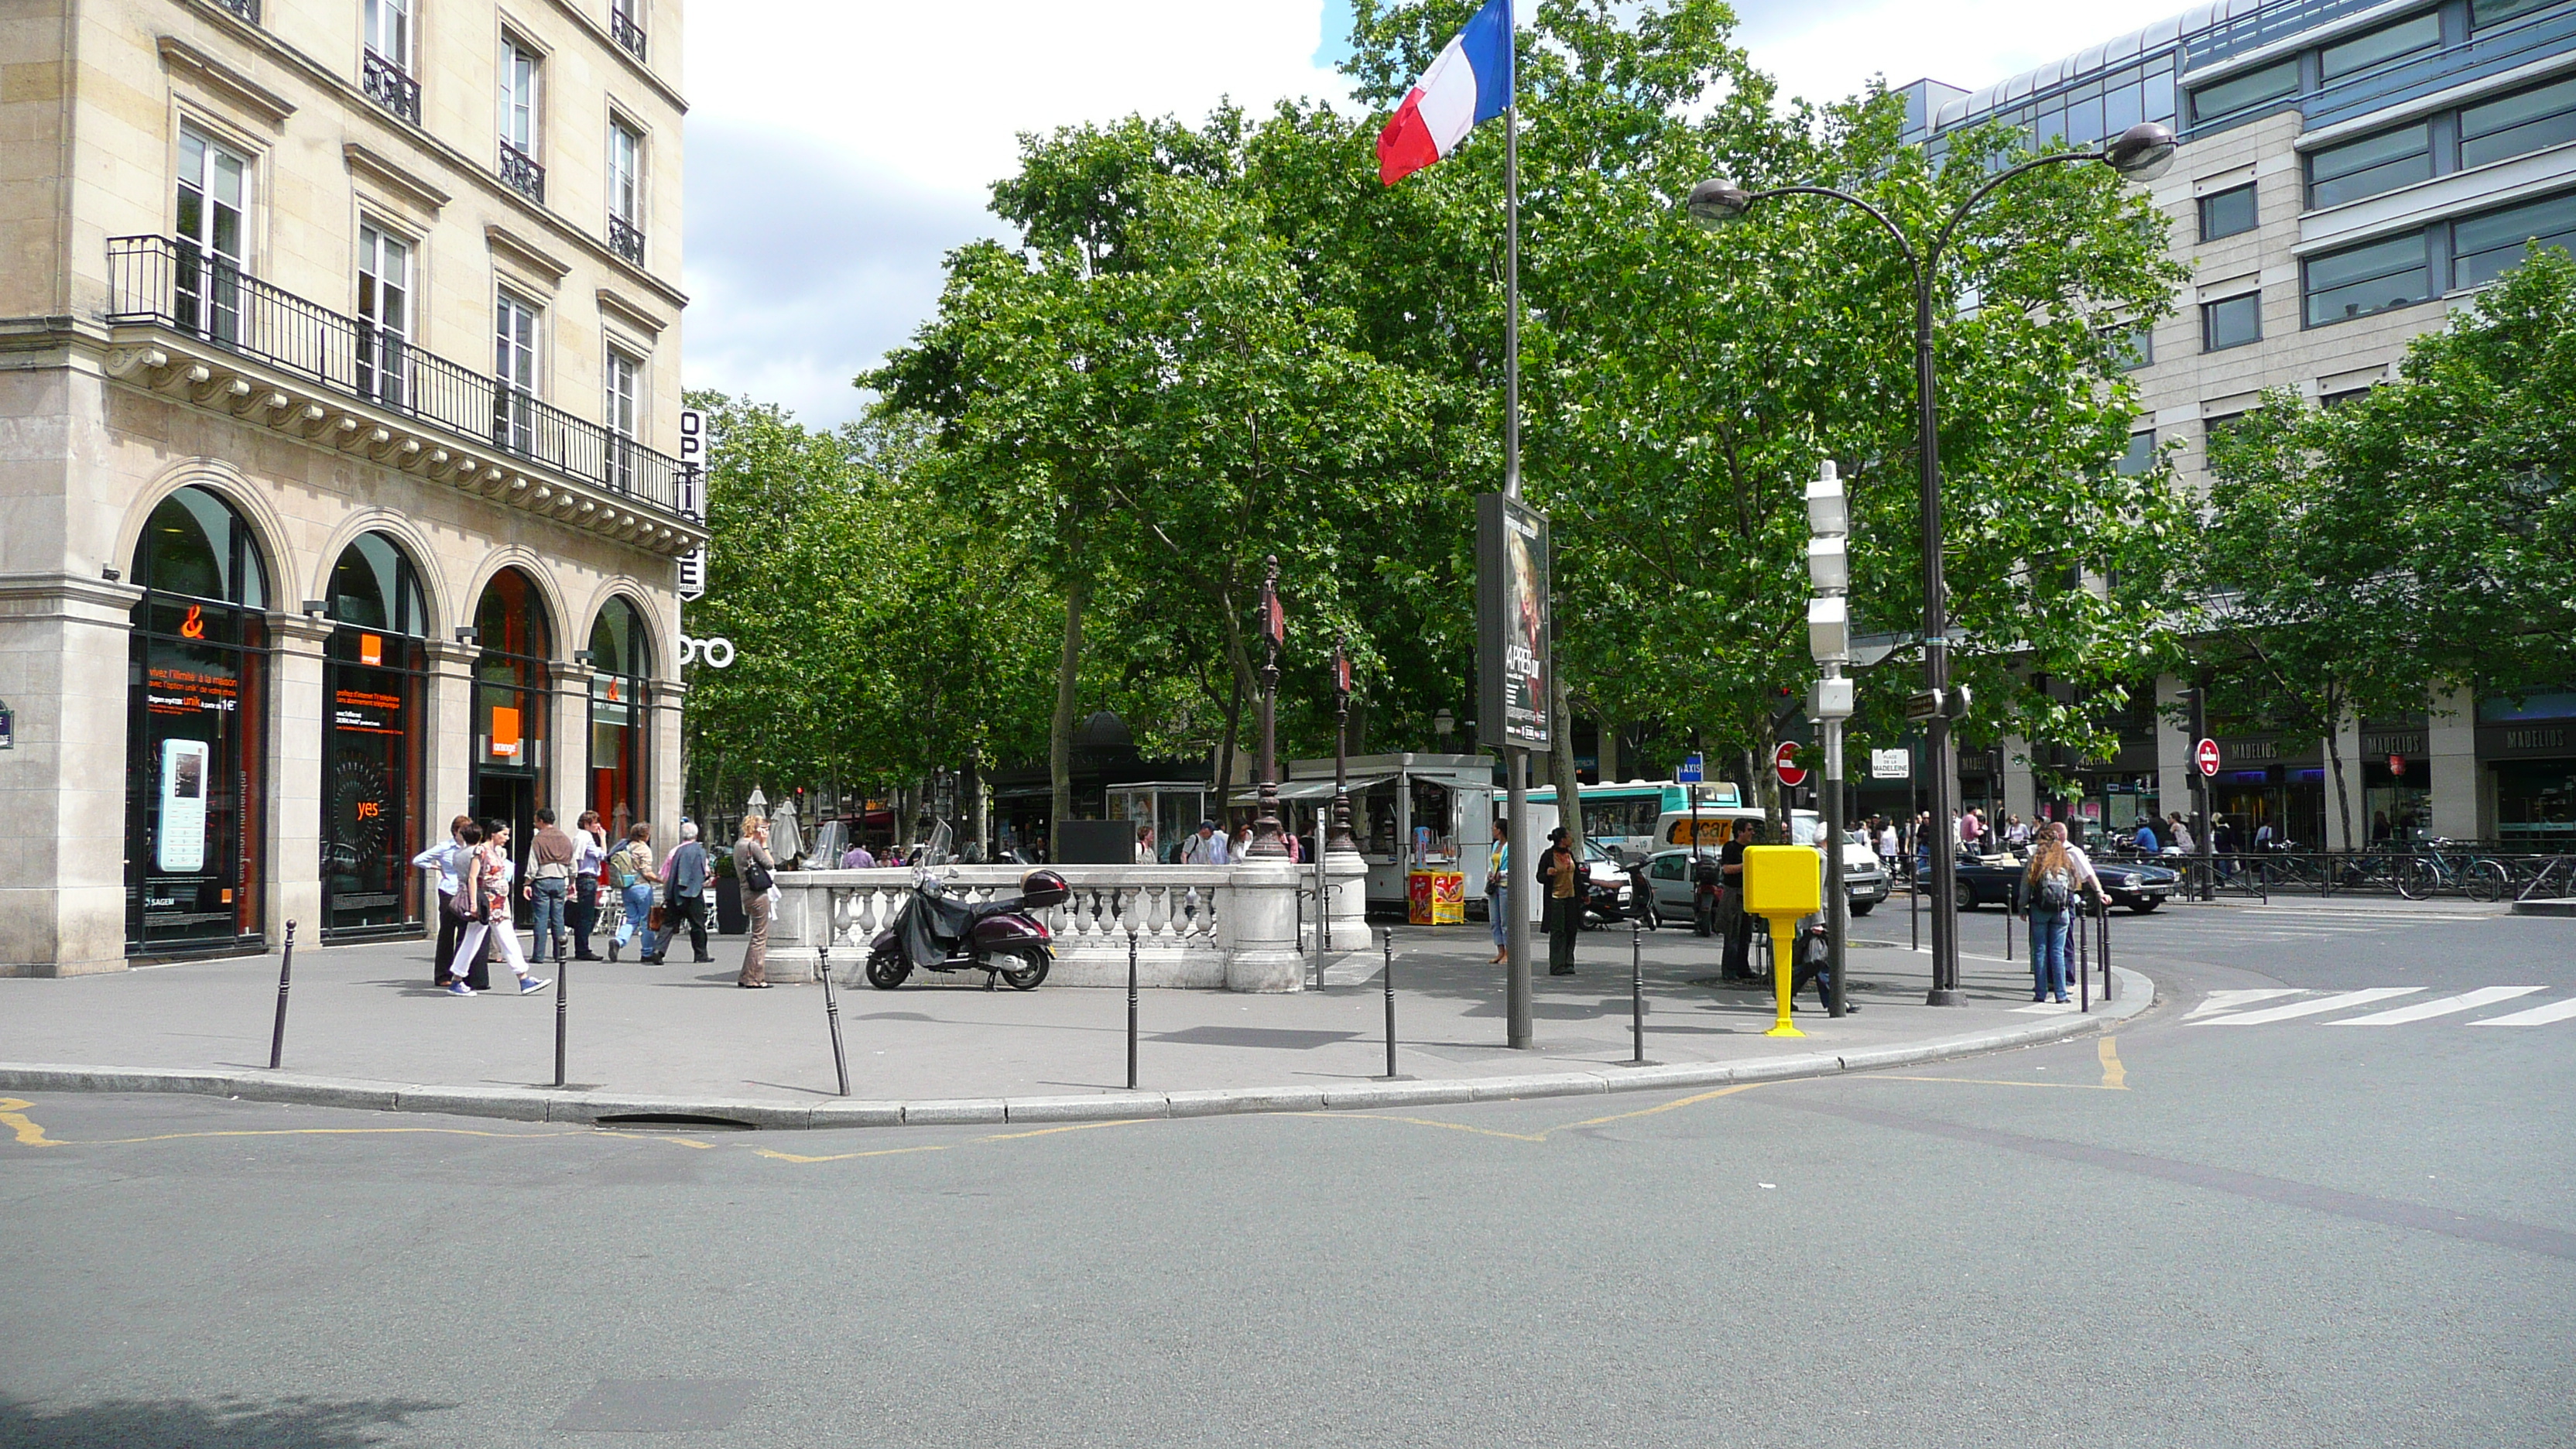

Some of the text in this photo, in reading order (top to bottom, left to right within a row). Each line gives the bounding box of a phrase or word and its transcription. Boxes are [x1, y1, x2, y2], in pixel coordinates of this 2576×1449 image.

[1506, 641, 1532, 675] APRÈS
[183, 696, 200, 707] unik
[2369, 737, 2420, 754] MADELIOS
[2507, 729, 2562, 748] MADELIOS
[493, 742, 517, 755] orange
[2232, 742, 2278, 759] MADELIOS
[357, 801, 379, 820] yes
[151, 898, 175, 906] SAGEM
